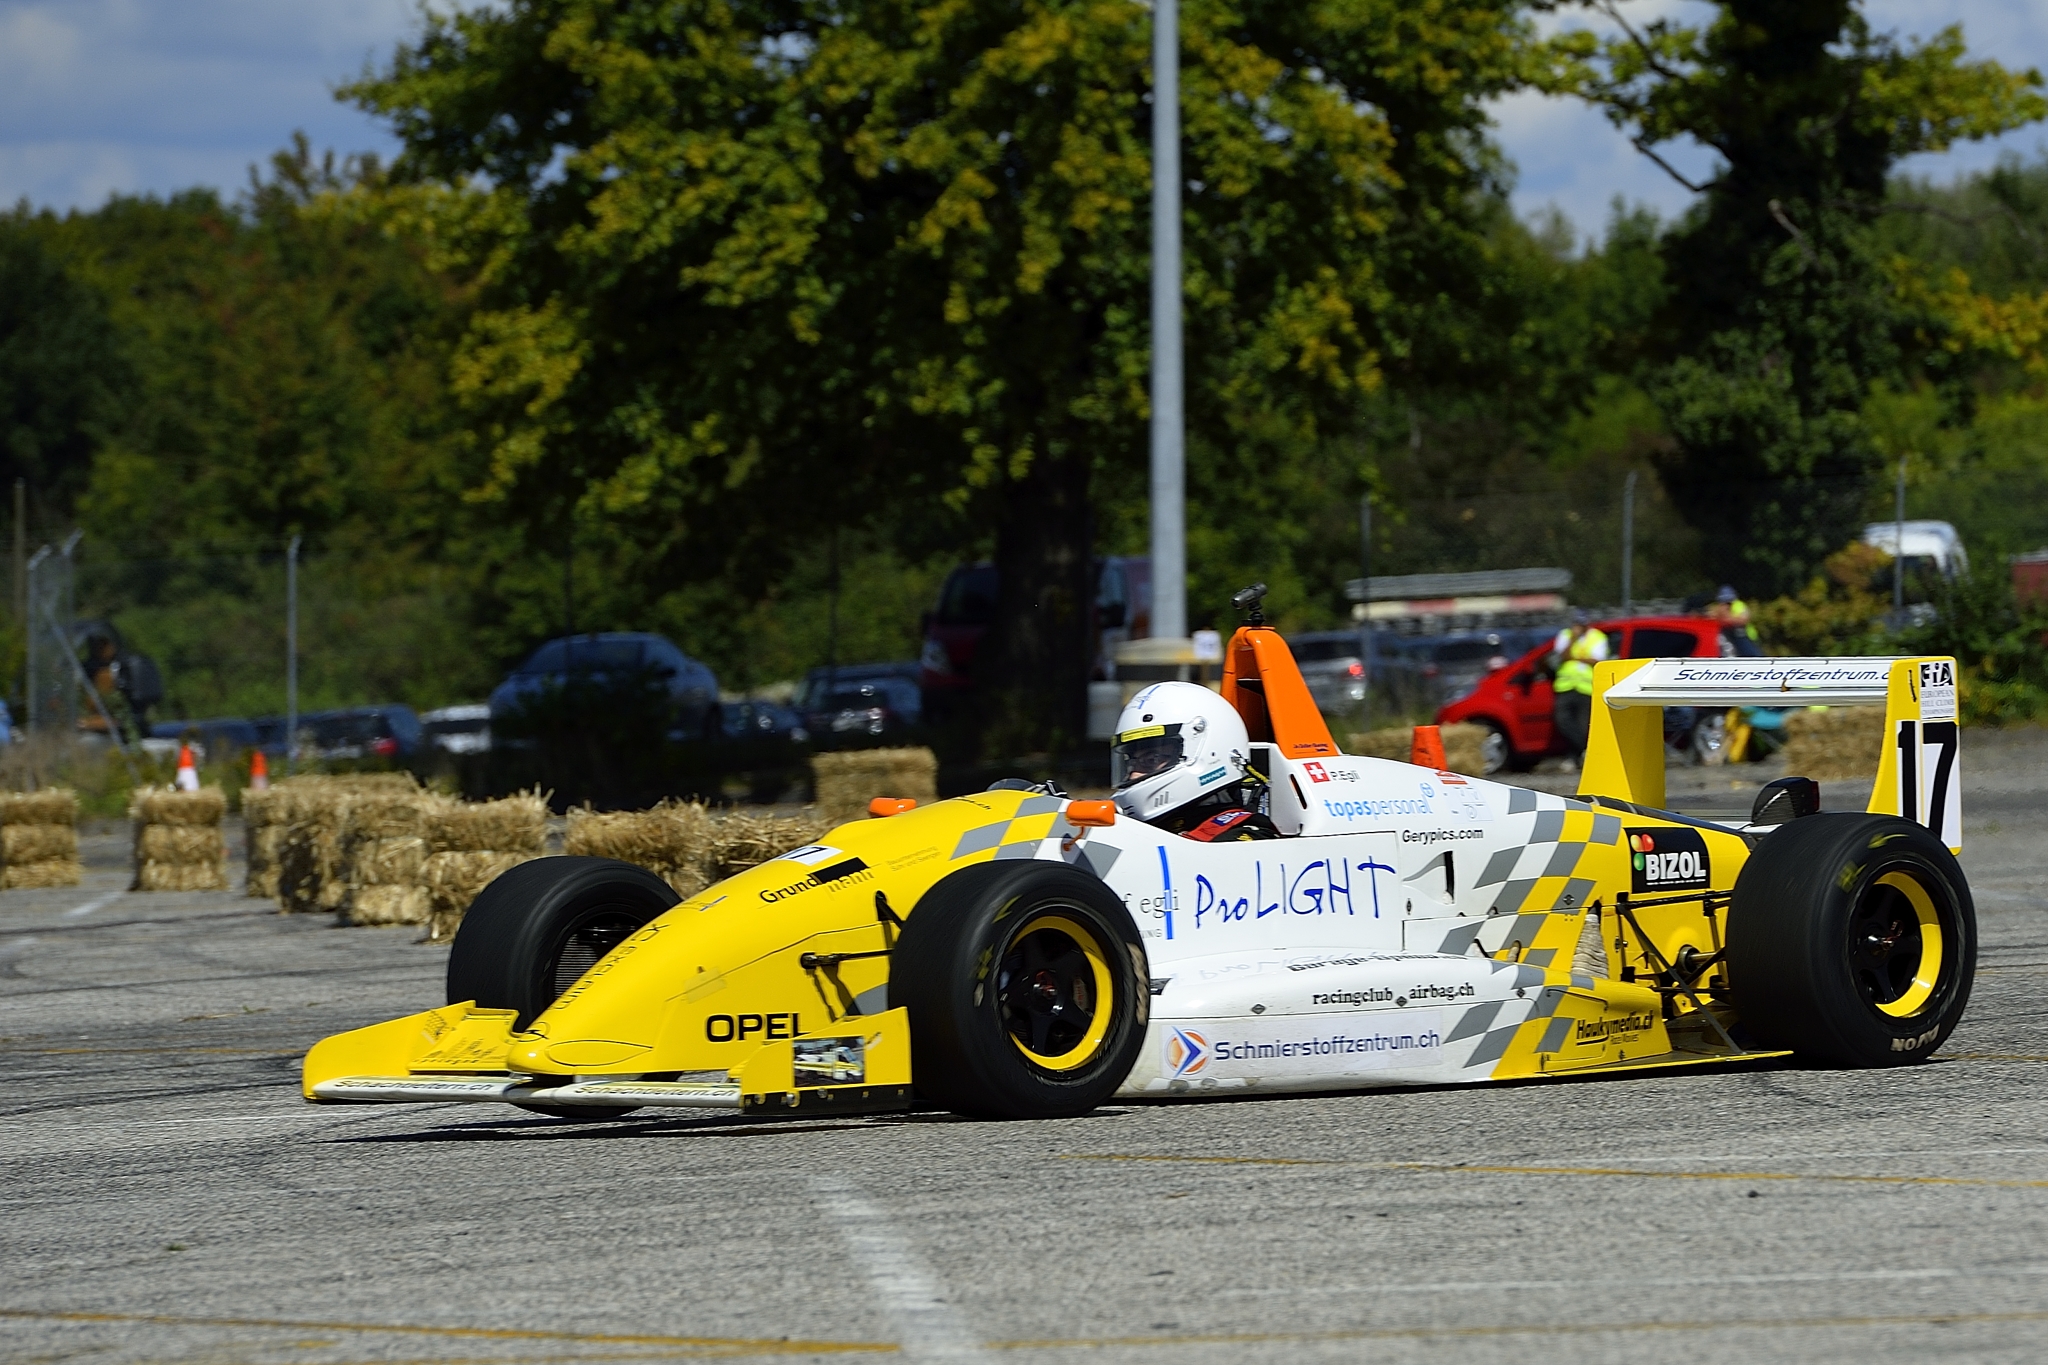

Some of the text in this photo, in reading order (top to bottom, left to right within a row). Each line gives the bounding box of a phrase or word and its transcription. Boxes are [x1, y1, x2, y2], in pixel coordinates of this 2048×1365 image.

[1898, 720, 1957, 840] 17
[1402, 828, 1484, 845] Gerypics.com
[1645, 851, 1707, 881] BIZOL
[1313, 982, 1475, 1006] racingclub airbag.ch
[706, 1012, 812, 1043] OPEL
[1215, 1029, 1440, 1061] Schmierstoffzentrum.ch
